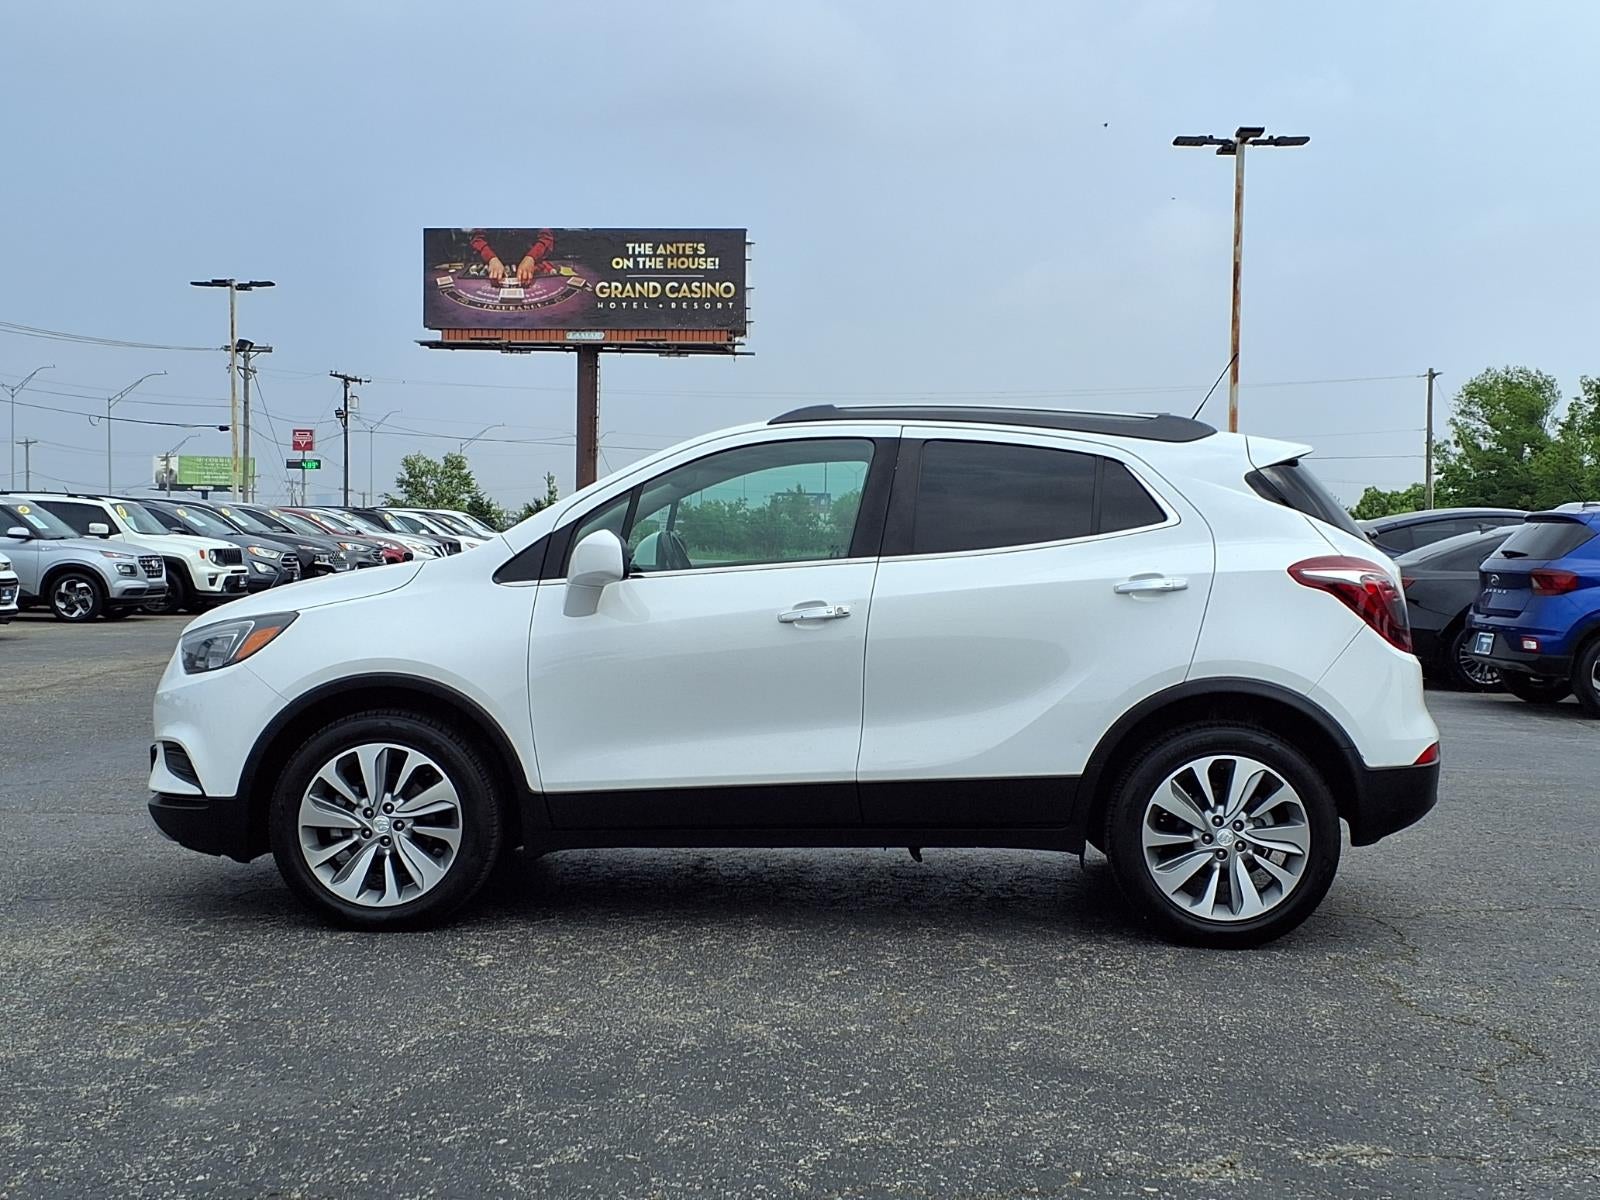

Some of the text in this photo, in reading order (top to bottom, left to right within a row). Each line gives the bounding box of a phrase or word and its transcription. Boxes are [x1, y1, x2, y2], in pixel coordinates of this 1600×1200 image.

[625, 242, 706, 255] THE ANTE'S
[611, 257, 720, 270] ON THE HOUSE!
[595, 281, 736, 299] GRAND CASINO
[671, 302, 735, 310] RESORT
